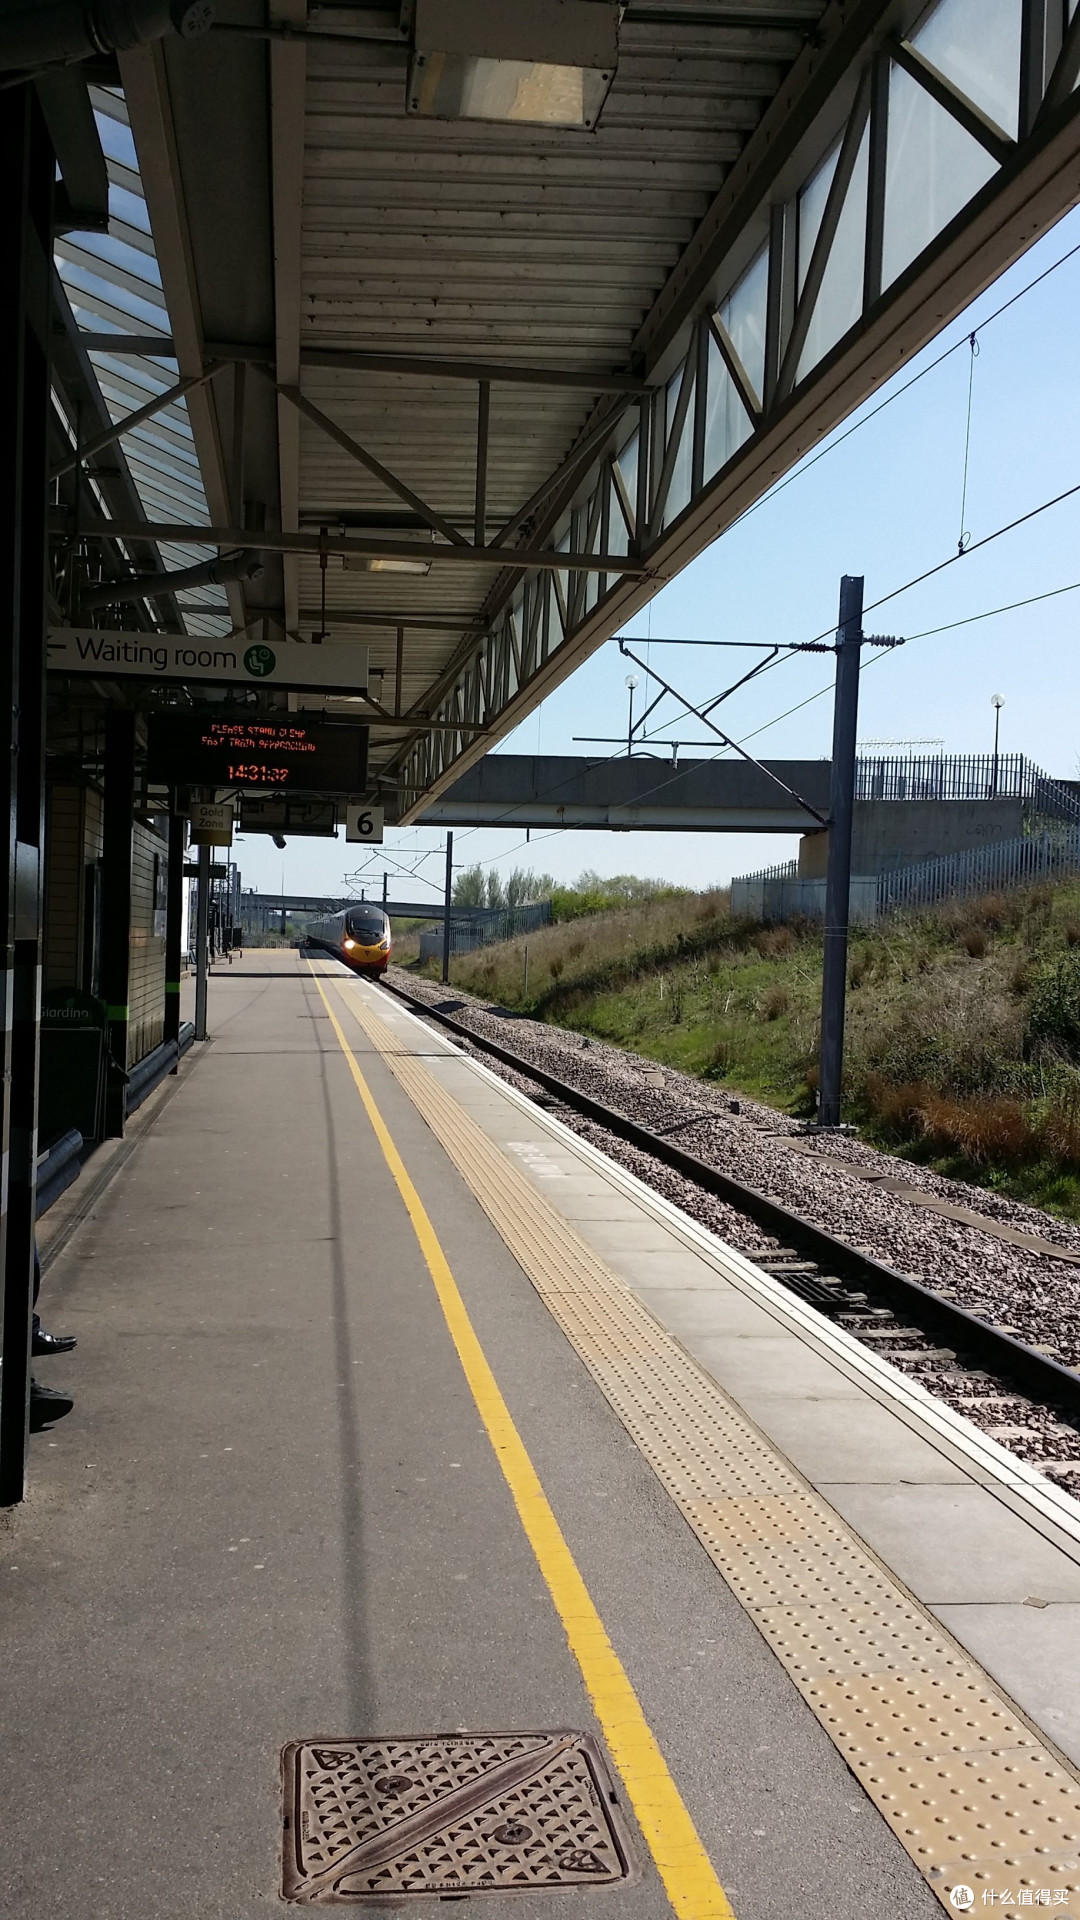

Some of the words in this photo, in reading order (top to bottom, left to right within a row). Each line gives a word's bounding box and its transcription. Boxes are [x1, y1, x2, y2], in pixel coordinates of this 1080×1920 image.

[76, 637, 168, 671] Waiting
[175, 650, 237, 668] room
[212, 723, 244, 734] PLEASE
[247, 726, 276, 737] STAND
[279, 728, 306, 739] CLEAR
[201, 736, 223, 746] FAST
[229, 738, 255, 748] TRAIN
[258, 739, 316, 751] APPROACHING
[200, 806, 224, 817] Gold
[198, 818, 224, 829] Zone
[357, 811, 374, 835] 6
